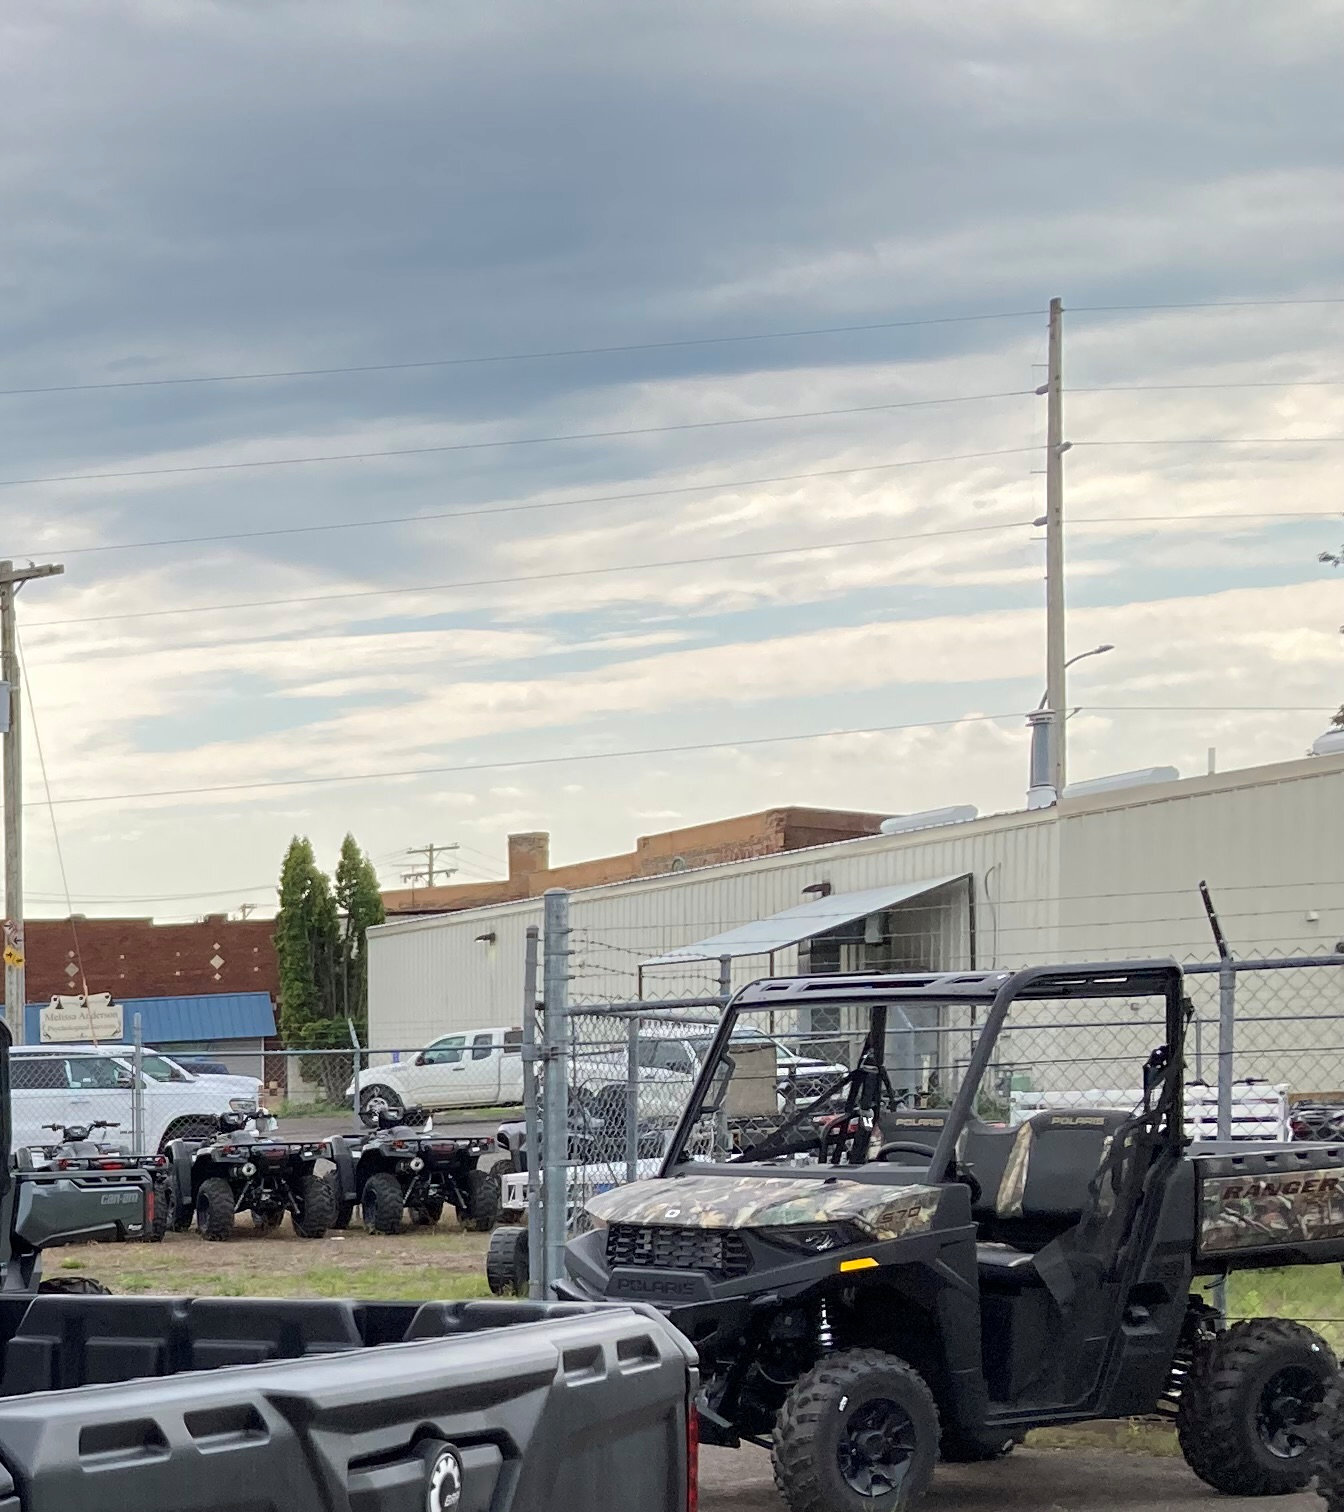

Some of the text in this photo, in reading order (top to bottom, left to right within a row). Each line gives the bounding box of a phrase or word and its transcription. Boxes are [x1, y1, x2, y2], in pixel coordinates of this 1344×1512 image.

[45, 1012, 77, 1021] Melissa
[895, 1117, 944, 1127] POLARIS
[1051, 1116, 1105, 1126] POLARIS
[1223, 1178, 1339, 1200] RANGER
[101, 1192, 139, 1205] can-am
[618, 1278, 696, 1295] POLARIS
